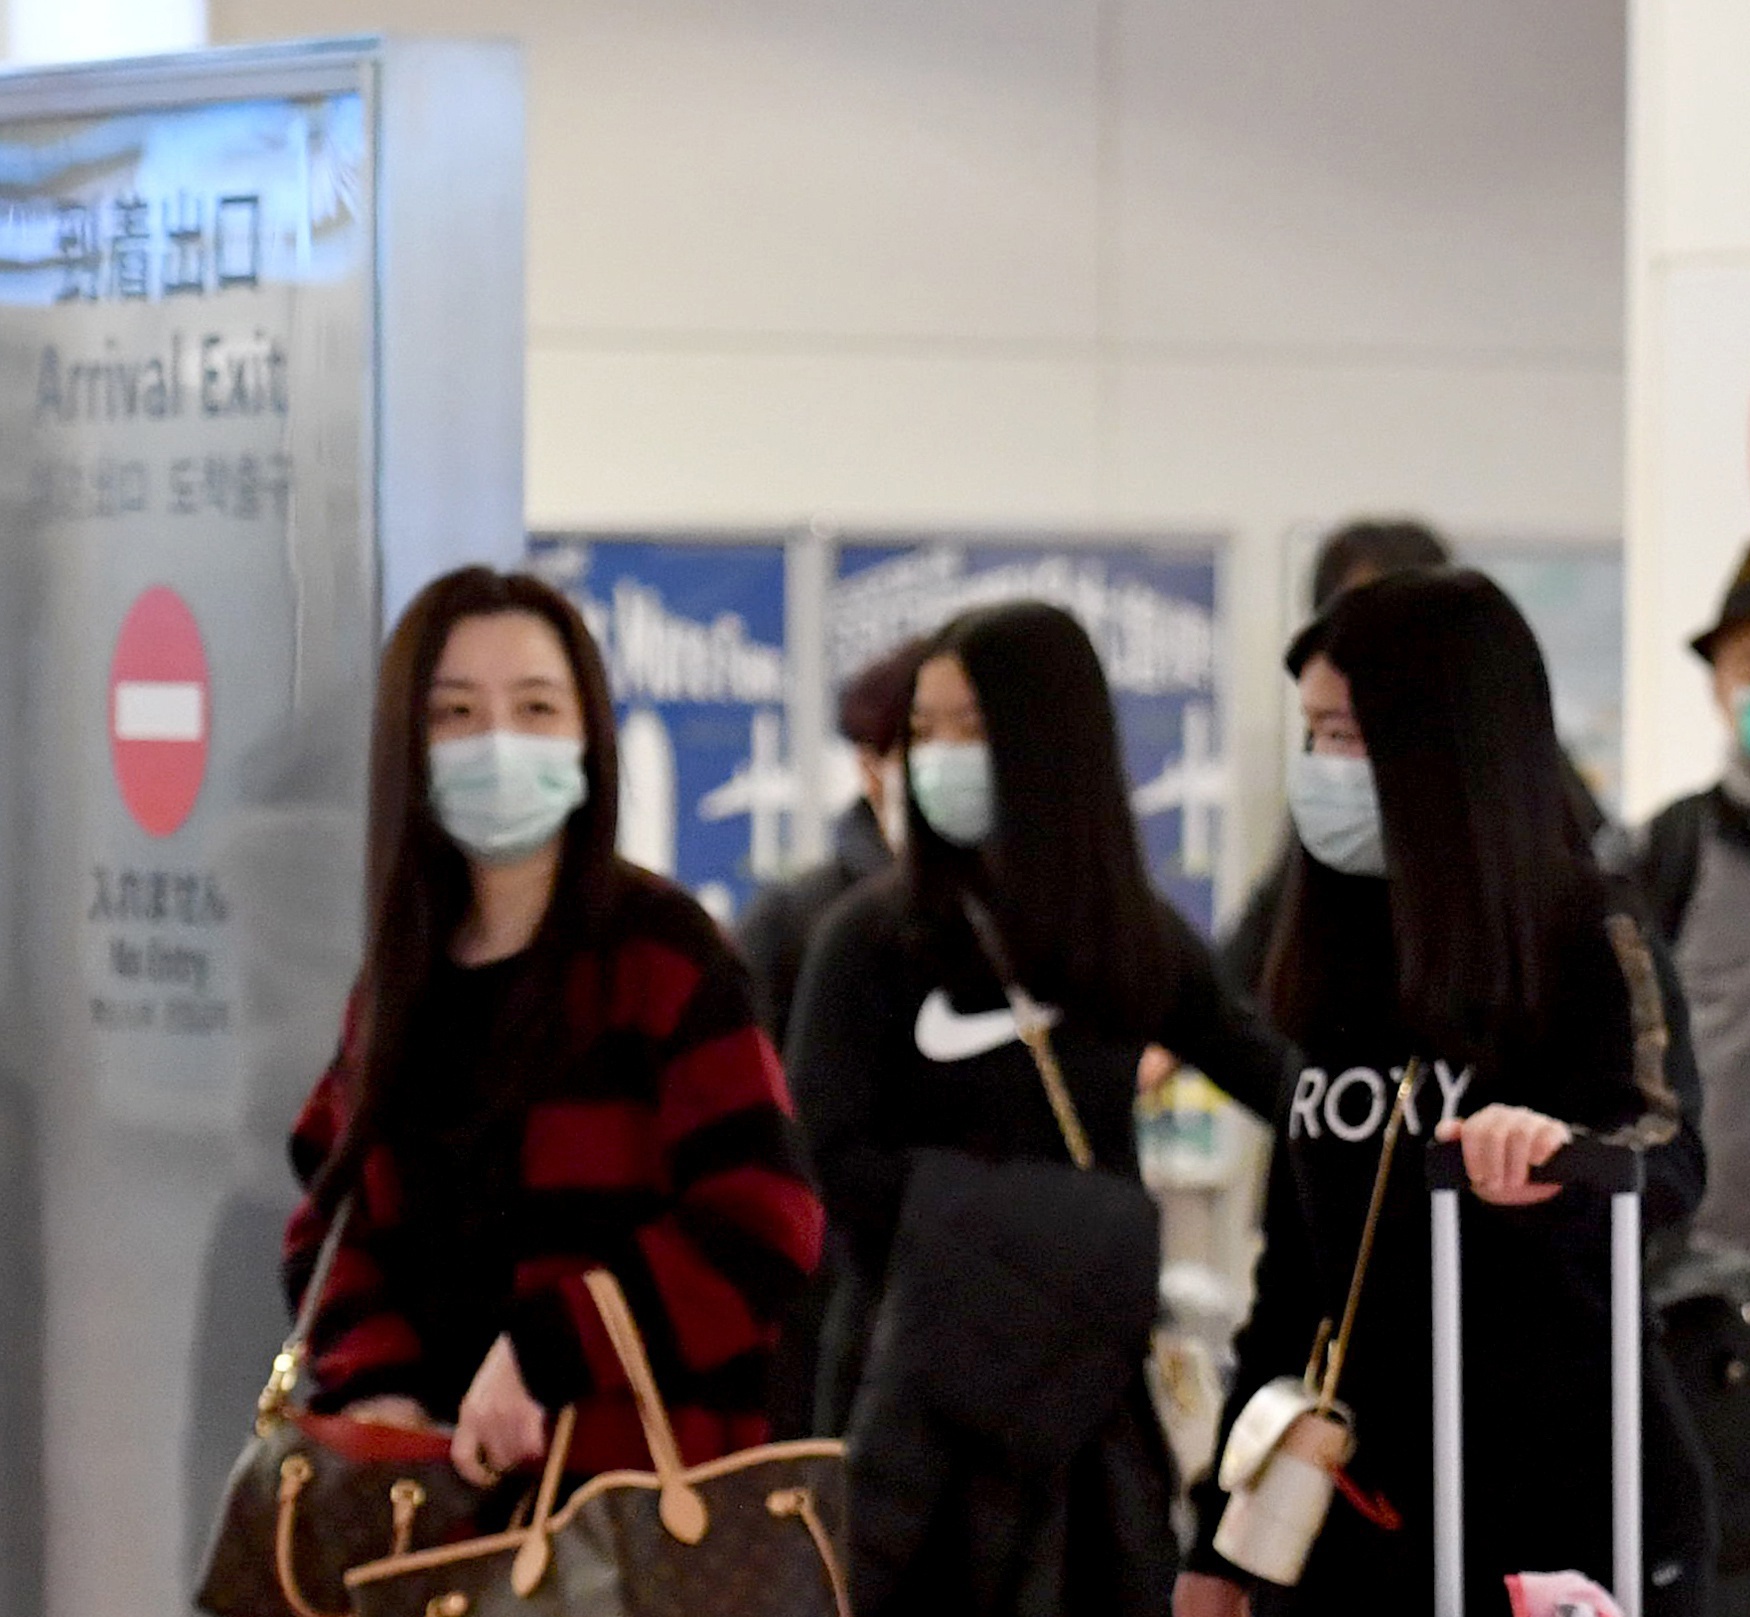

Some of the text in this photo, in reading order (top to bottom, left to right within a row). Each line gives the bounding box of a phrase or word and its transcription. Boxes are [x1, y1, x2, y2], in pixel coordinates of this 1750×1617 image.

[38, 326, 288, 425] Arrival Exit
[1289, 1058, 1478, 1142] ROXY
